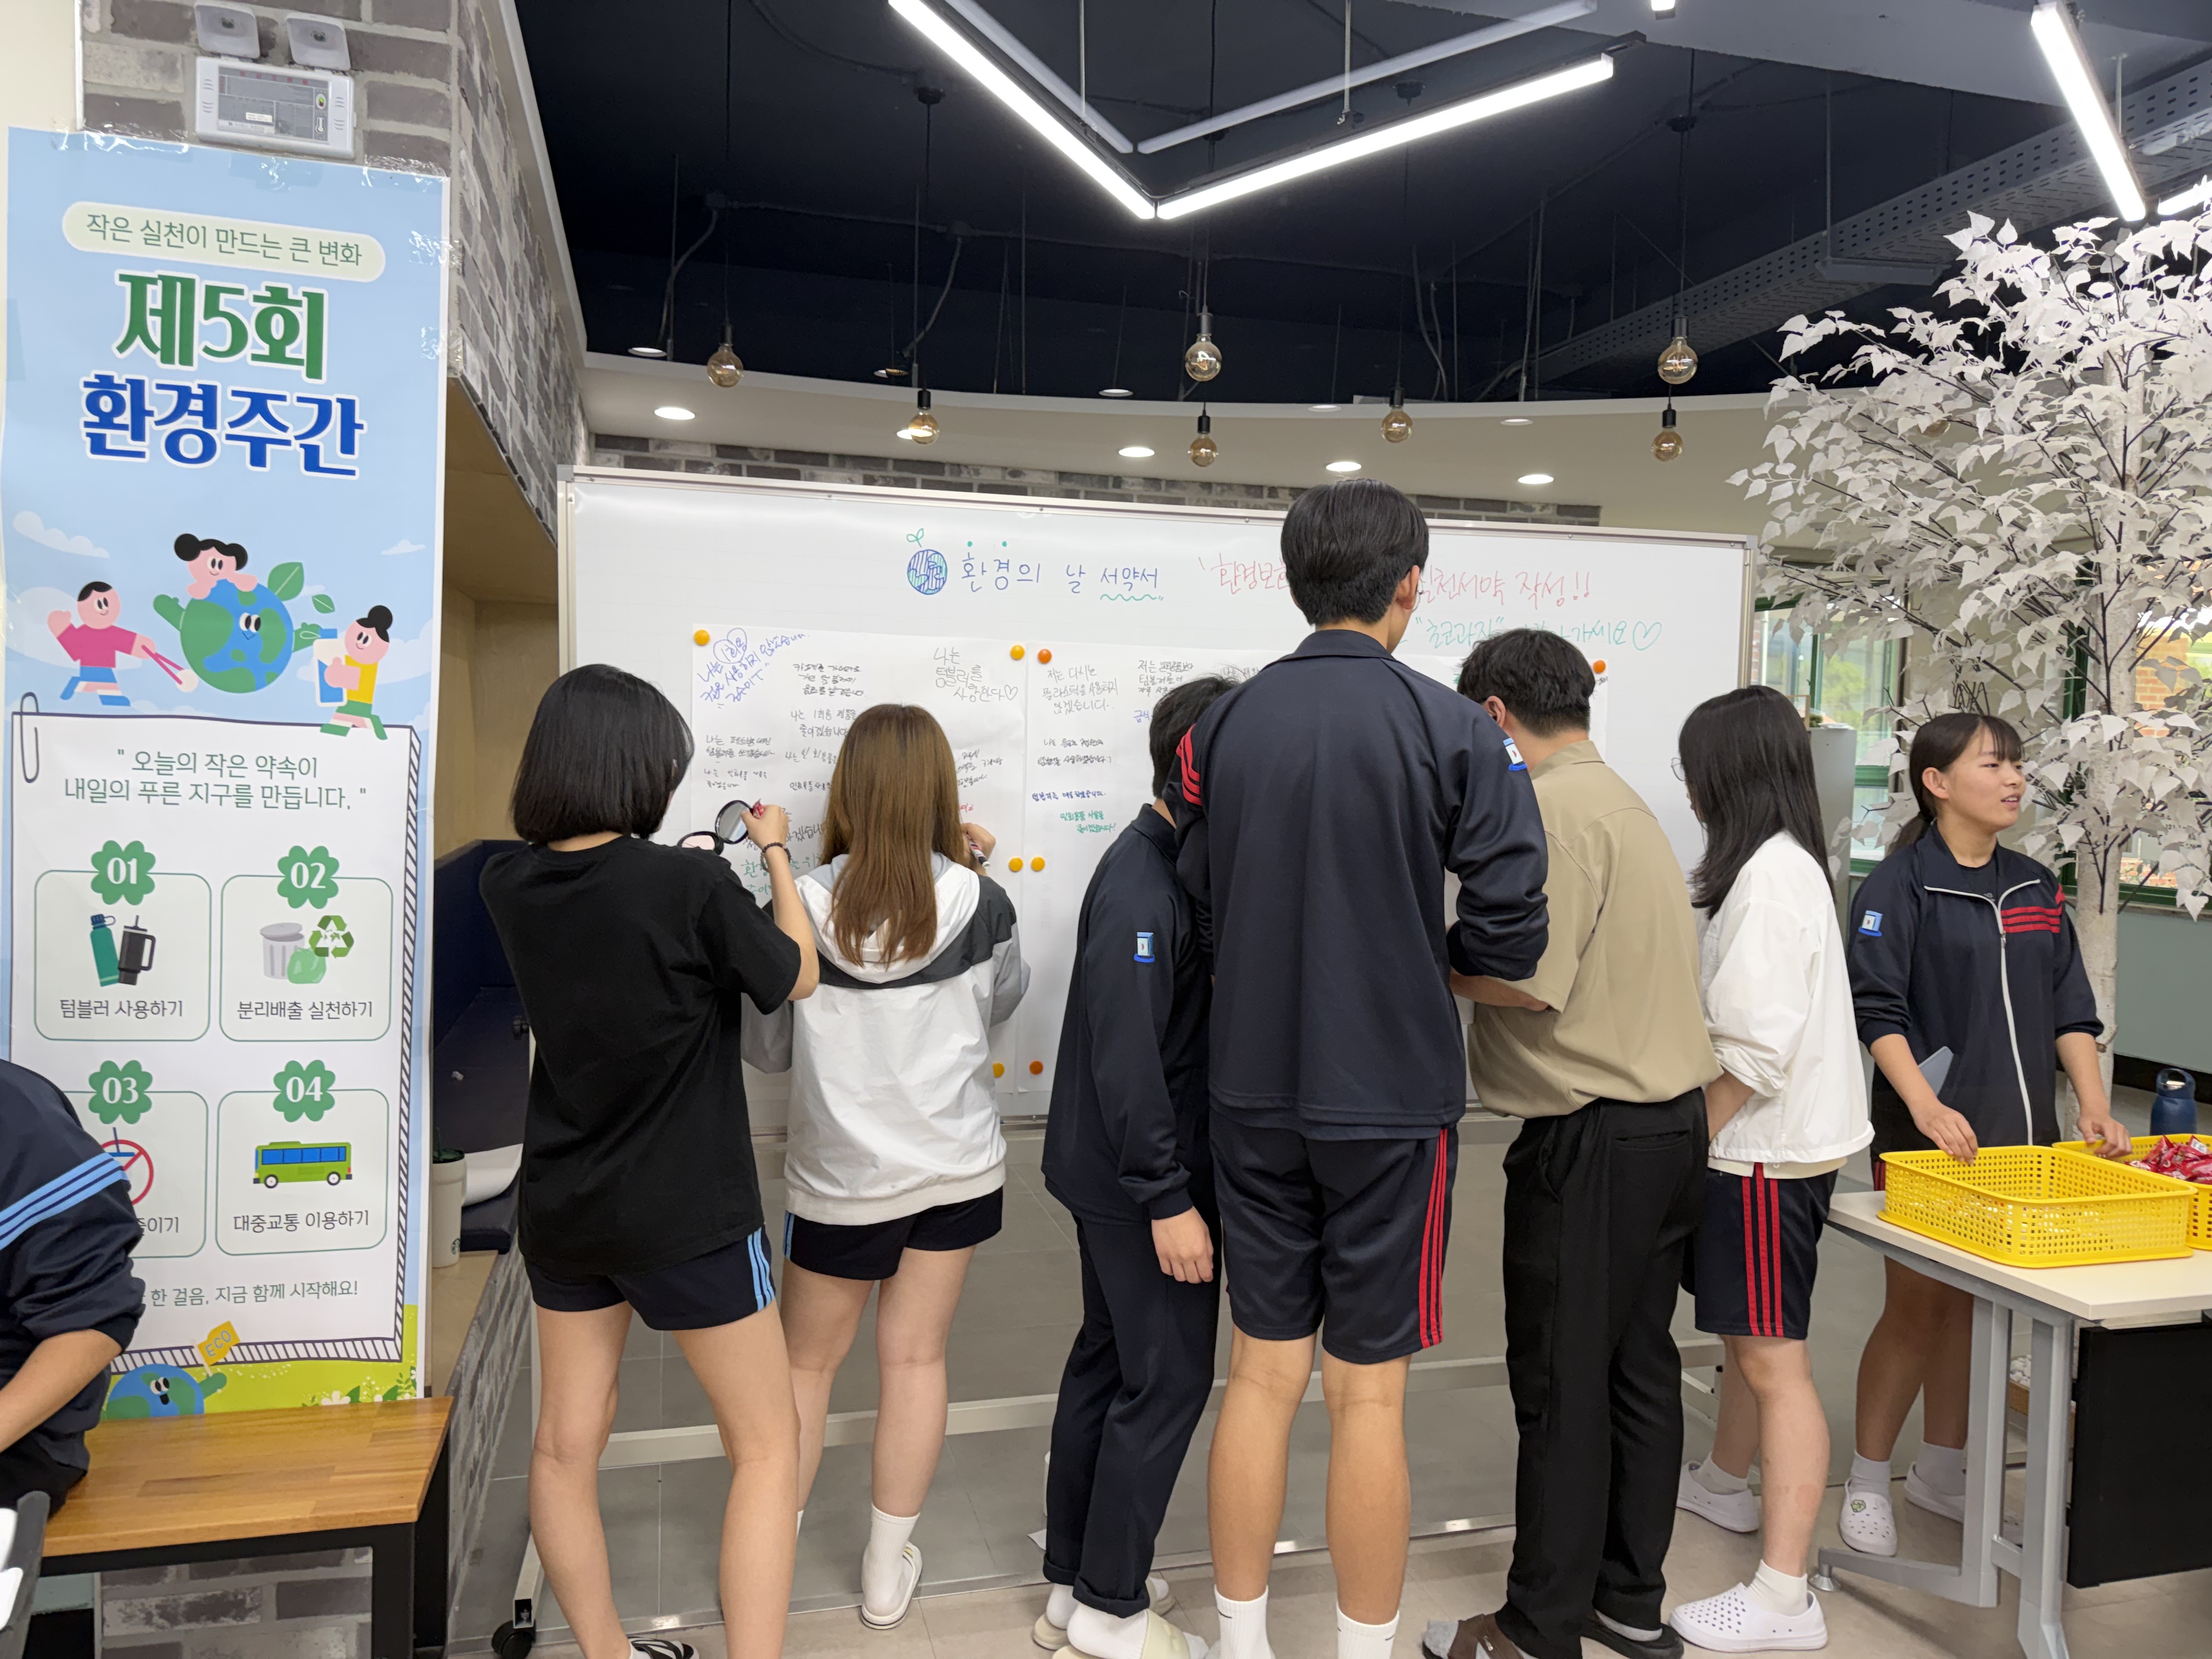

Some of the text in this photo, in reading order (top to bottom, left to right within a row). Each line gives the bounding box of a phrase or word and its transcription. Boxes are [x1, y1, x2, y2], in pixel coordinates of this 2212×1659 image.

[87, 215, 362, 266] 작은 실천이 만드는 큰 변화
[115, 273, 325, 380] 제5회
[83, 374, 364, 477] 환경주간
[1066, 565, 1085, 594] 날
[1101, 567, 1157, 591] 서약서
[1515, 571, 1590, 610] 작성!!
[725, 650, 761, 686] 사용하지
[933, 646, 960, 665] 나는
[1137, 660, 1156, 673] 저는
[936, 664, 983, 688] 텀블러를
[1047, 664, 1097, 684] 저는 다시는
[1139, 673, 1175, 686] 텀블러를
[953, 684, 1006, 702] 사랑한다
[1042, 678, 1119, 701] 플라스틱을 사용하지
[791, 709, 805, 721] 나는
[706, 735, 725, 746] 나는
[132, 752, 317, 780] 오늘의 작은 약속이
[65, 778, 129, 803] 내일의
[138, 782, 181, 805] 푸른
[189, 783, 253, 808] 지구를
[261, 786, 350, 809] 만듭니다.
[107, 859, 139, 884] 01
[290, 863, 326, 889] 02
[60, 1000, 182, 1019] 텀블러 사용하기
[238, 1001, 372, 1020] 분리배출 실천하기
[102, 1077, 138, 1104] 03
[286, 1077, 323, 1103] 04
[234, 1210, 368, 1233] 대중교통 이용하기
[151, 1281, 357, 1307] 한 걸음, 지금 함께 시작해요!
[205, 1330, 231, 1357] ECO
